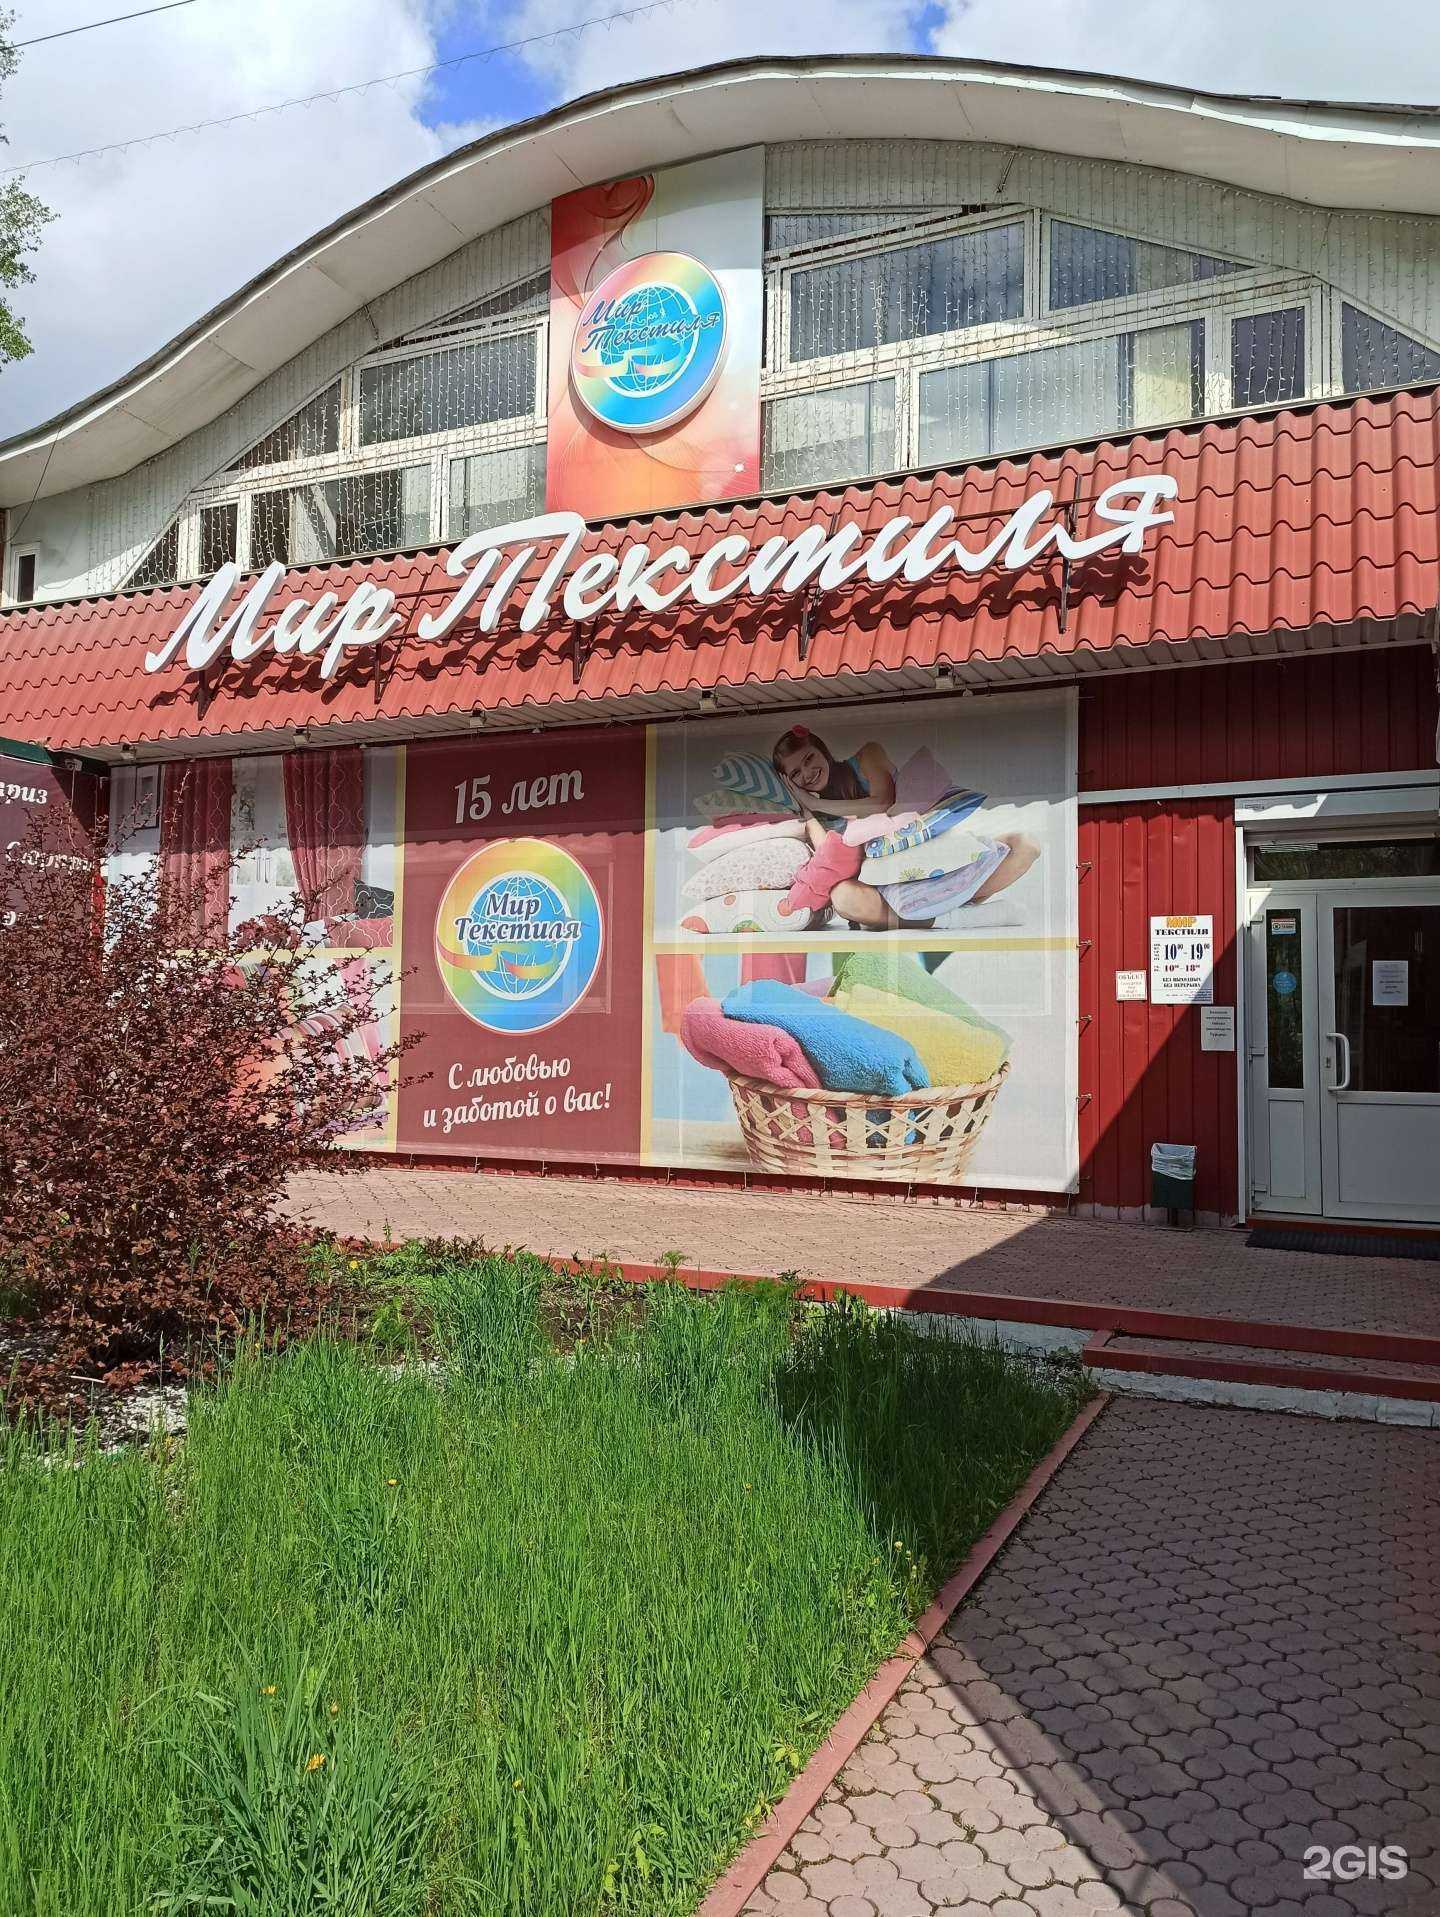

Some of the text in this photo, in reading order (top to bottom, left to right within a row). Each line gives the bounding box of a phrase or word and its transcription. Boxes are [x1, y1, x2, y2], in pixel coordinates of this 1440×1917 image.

[582, 298, 645, 326] Мир
[581, 312, 721, 353] Текстиля
[144, 474, 1178, 680] Мир Текстиля
[454, 768, 584, 824] 15 лет
[485, 891, 542, 922] Мир
[453, 917, 582, 944] Текстиля
[1154, 928, 1209, 936] ТЕКСТИЛЯ
[448, 1052, 571, 1090] С любовью
[423, 1083, 611, 1134] и заботой о вас!
